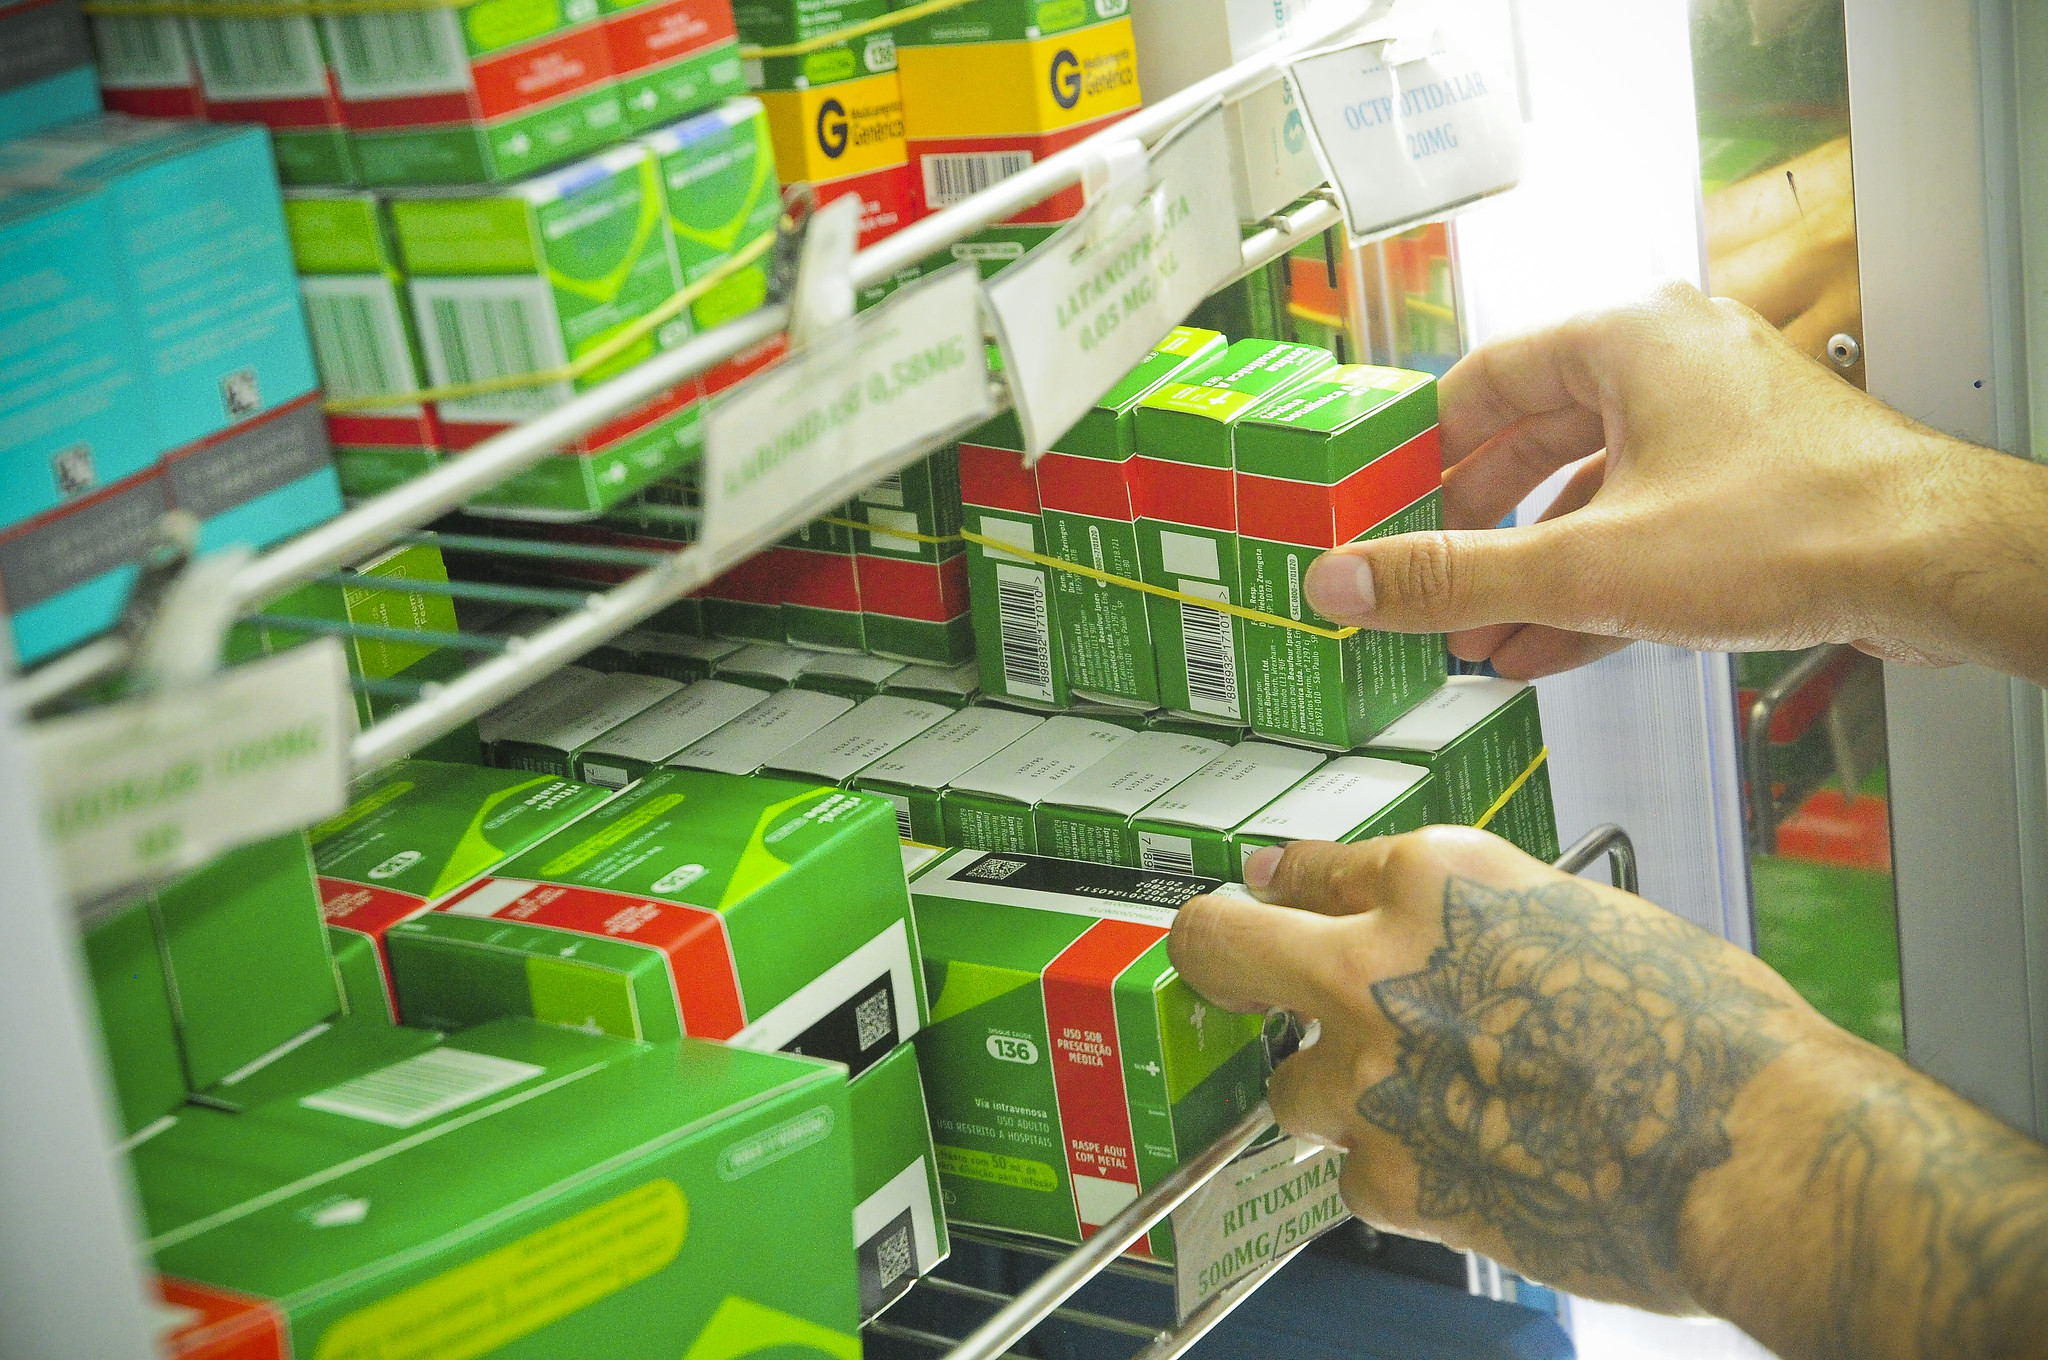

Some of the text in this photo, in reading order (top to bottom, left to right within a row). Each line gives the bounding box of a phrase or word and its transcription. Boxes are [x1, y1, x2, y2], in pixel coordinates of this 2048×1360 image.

[1051, 49, 1081, 109] G
[1084, 67, 1133, 96] Genérico
[818, 99, 848, 159] G
[854, 120, 905, 146] Genérico
[1406, 123, 1459, 160] 20MG
[1264, 347, 1310, 372] toxina
[1058, 519, 1070, 551] Zeringota
[1255, 547, 1265, 611] Heloisa Zeringota
[1264, 579, 1273, 601] 10.078
[1288, 558, 1298, 602] 0800-7701820
[1035, 590, 1045, 634] 171010
[1092, 592, 1105, 642] Beaufour Ipsen
[1111, 611, 1119, 626] 1297
[1284, 627, 1293, 646] Ipsen
[1038, 640, 1050, 683] 898932
[1073, 622, 1090, 686] Ipsen Biopharm Ltd.
[1220, 612, 1238, 714] 7 898932 17101
[1268, 644, 1277, 674] Wrexham
[1285, 648, 1294, 680] Beaufour
[1108, 649, 1120, 692] Farmacêutica
[1312, 671, 1320, 683] São
[1261, 657, 1274, 727] Ipsen Biopharm Ltd.
[1270, 675, 1279, 696] North,
[1294, 639, 1306, 733] Farmacêutica Ltda. Avenida
[1304, 673, 1313, 698] Berrini,
[1255, 678, 1264, 725] Fabricado por:
[1272, 697, 1280, 715] Road
[1288, 696, 1298, 731] Importado
[1306, 699, 1314, 720] Carlos
[1281, 709, 1289, 728] Reino
[1307, 721, 1315, 734] Luiz
[524, 782, 567, 807] mabe
[967, 809, 978, 843] Luiz Carlos
[982, 812, 994, 846] Importado
[991, 815, 1000, 834] Reino
[1000, 828, 1009, 845] Road
[1006, 815, 1016, 836] Ipsen
[1015, 816, 1026, 850] Fabricado
[1086, 826, 1095, 846] Reino
[1103, 827, 1112, 847] Ipsen
[1061, 820, 1072, 856] Luiz Carlos
[1078, 823, 1089, 859] Importado
[1096, 840, 1105, 857] Road
[1111, 828, 1122, 862] Fabricado
[1134, 887, 1168, 896] 2021
[1149, 878, 1184, 886] 2019
[1057, 1038, 1112, 1057] PRESCRIÇÃO
[1063, 1028, 1102, 1043] USO SOB
[994, 1039, 1031, 1061] 136
[974, 1098, 1048, 1118] Via intravenosa
[956, 1122, 995, 1137] RESTRITO
[998, 1129, 1004, 1139] A
[1007, 1131, 1052, 1147] HOSPITAIS
[996, 1115, 1050, 1133] USO ADULTO
[1072, 1140, 1127, 1158] RASPE AQUI
[1075, 1151, 1128, 1169] COM METAL
[992, 1155, 1006, 1169] 50
[1199, 1193, 1344, 1296] 500MG/50ML
